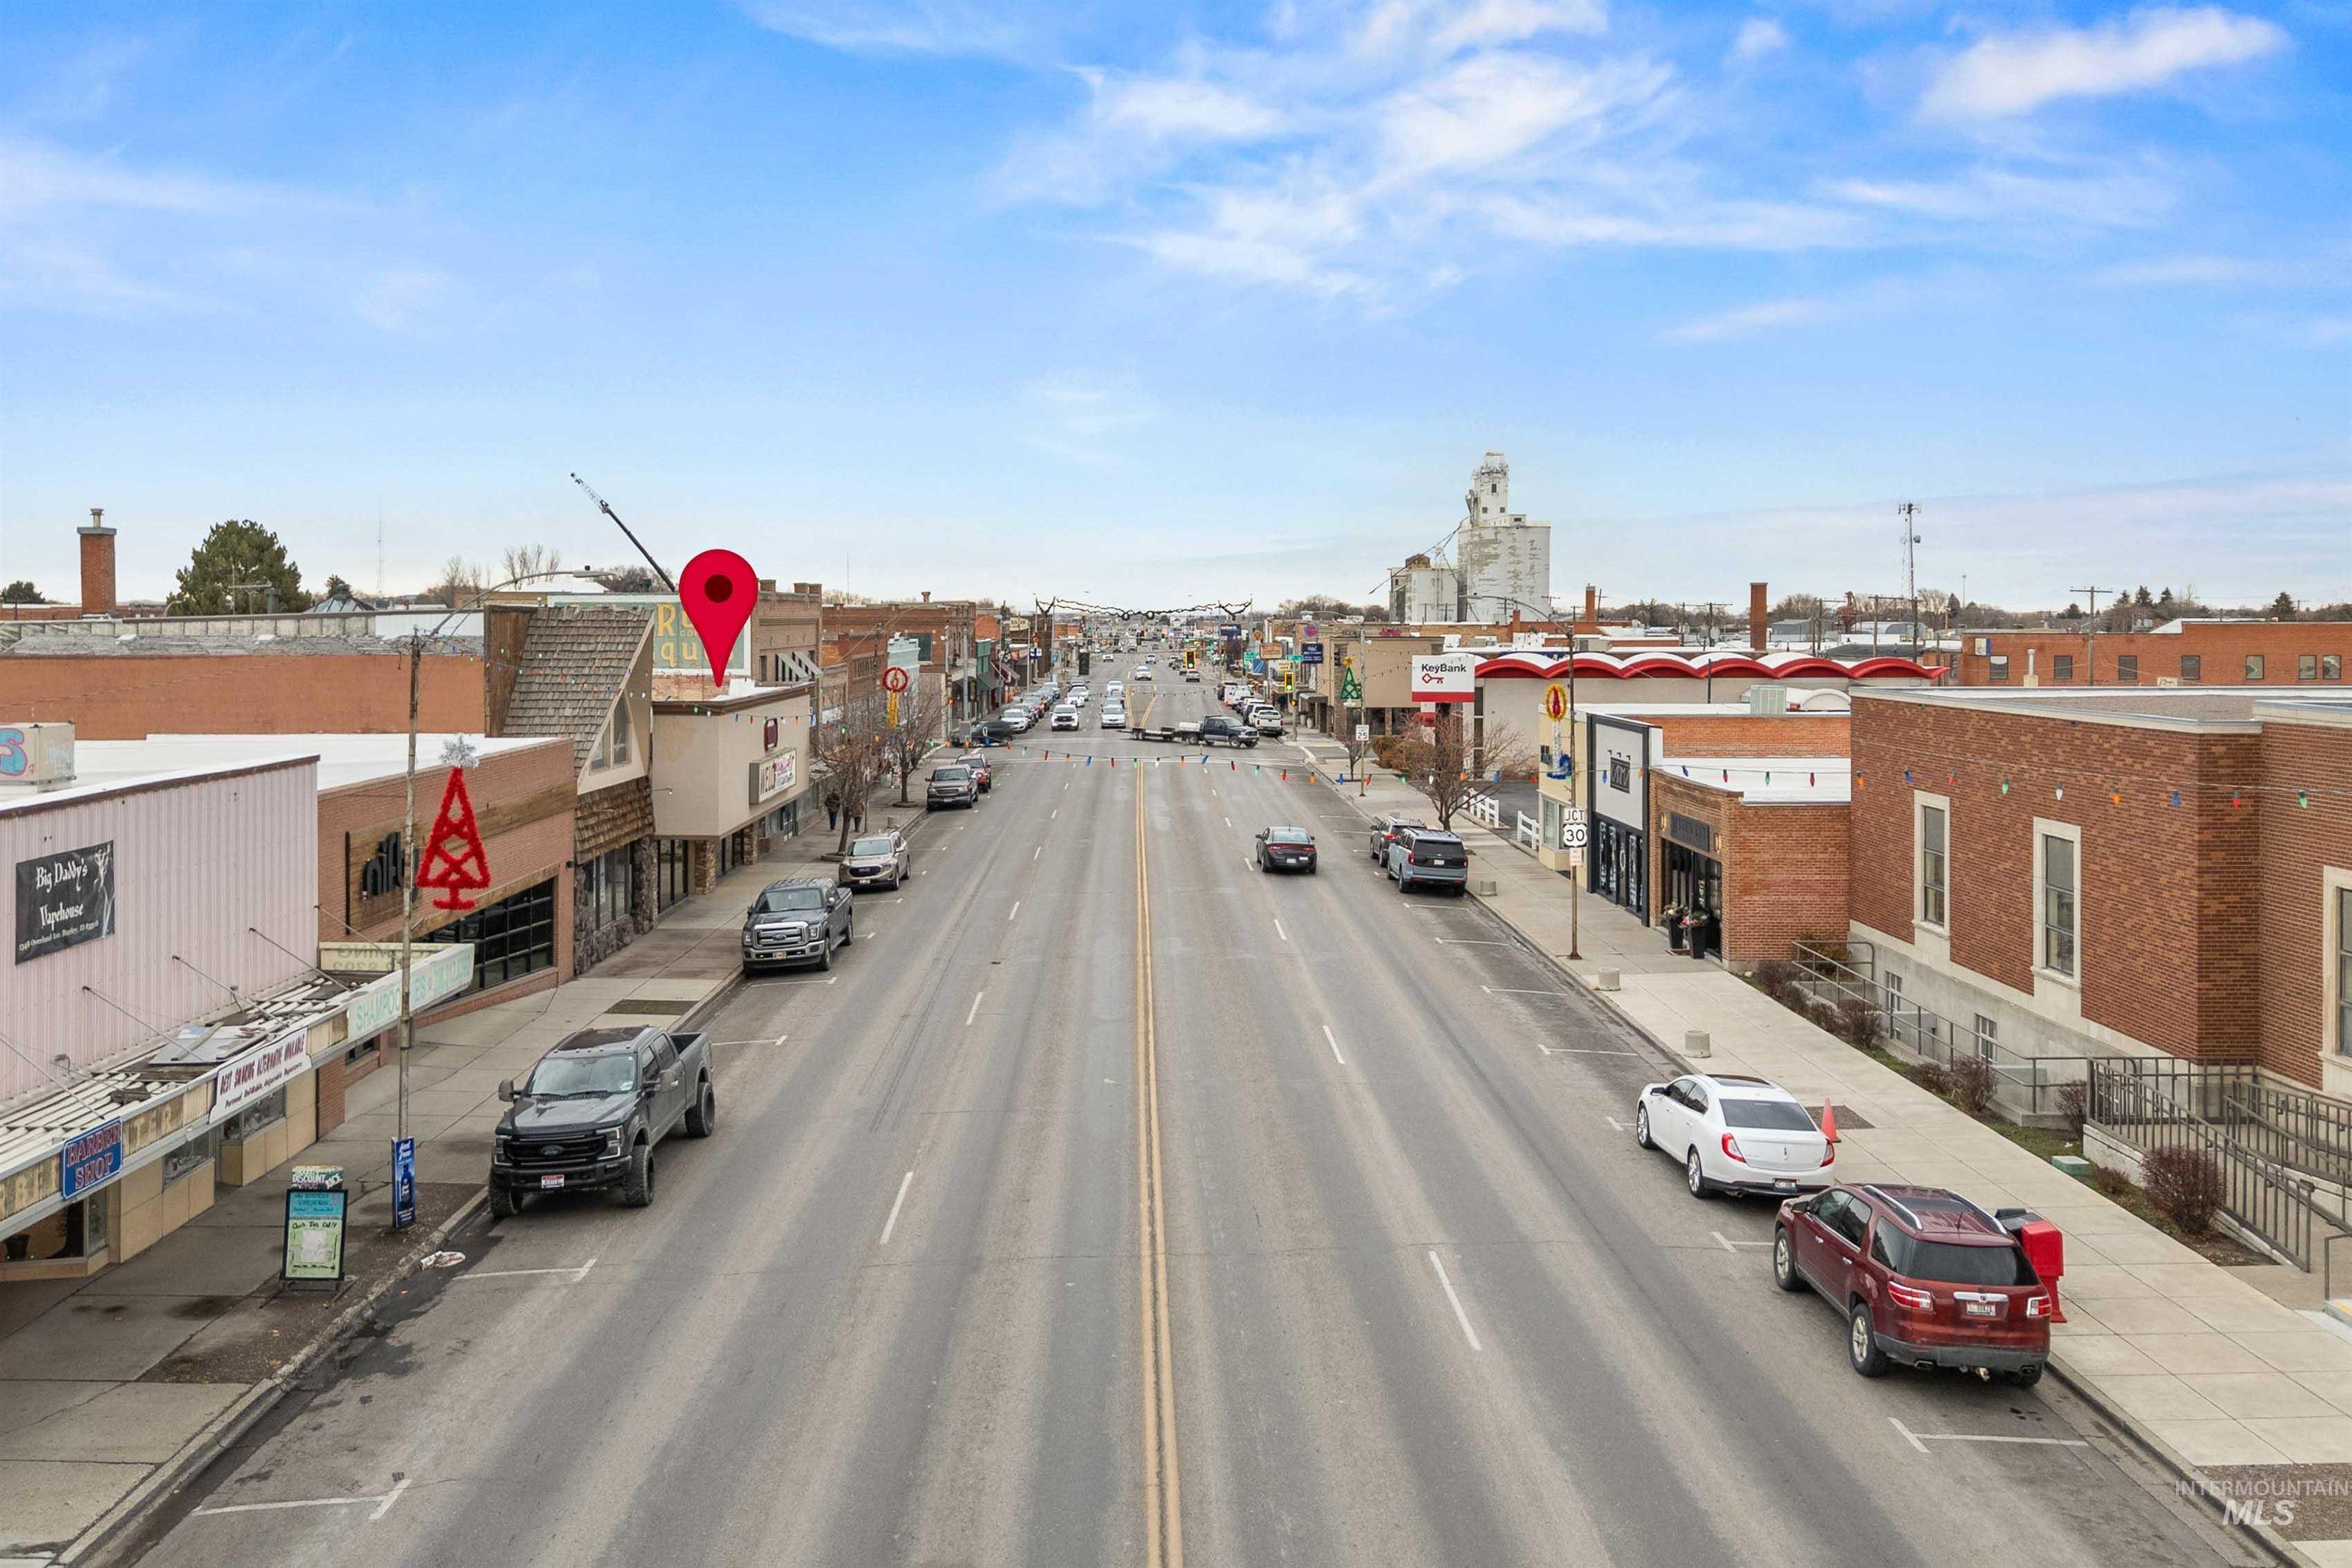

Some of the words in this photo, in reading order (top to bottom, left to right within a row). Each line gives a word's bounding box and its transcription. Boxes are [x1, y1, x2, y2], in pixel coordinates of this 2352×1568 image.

[1422, 664, 1466, 672] KeyBank
[1566, 810, 1584, 821] JCT
[1566, 829, 1584, 841] 30
[36, 866, 53, 893] Big
[54, 858, 88, 892] Daddy's
[39, 902, 83, 931] Vapehouse
[220, 1070, 232, 1096] BEST
[67, 1122, 121, 1167] BARBER
[75, 1152, 113, 1189] SHOP
[292, 1172, 326, 1184] DISCOUNT
